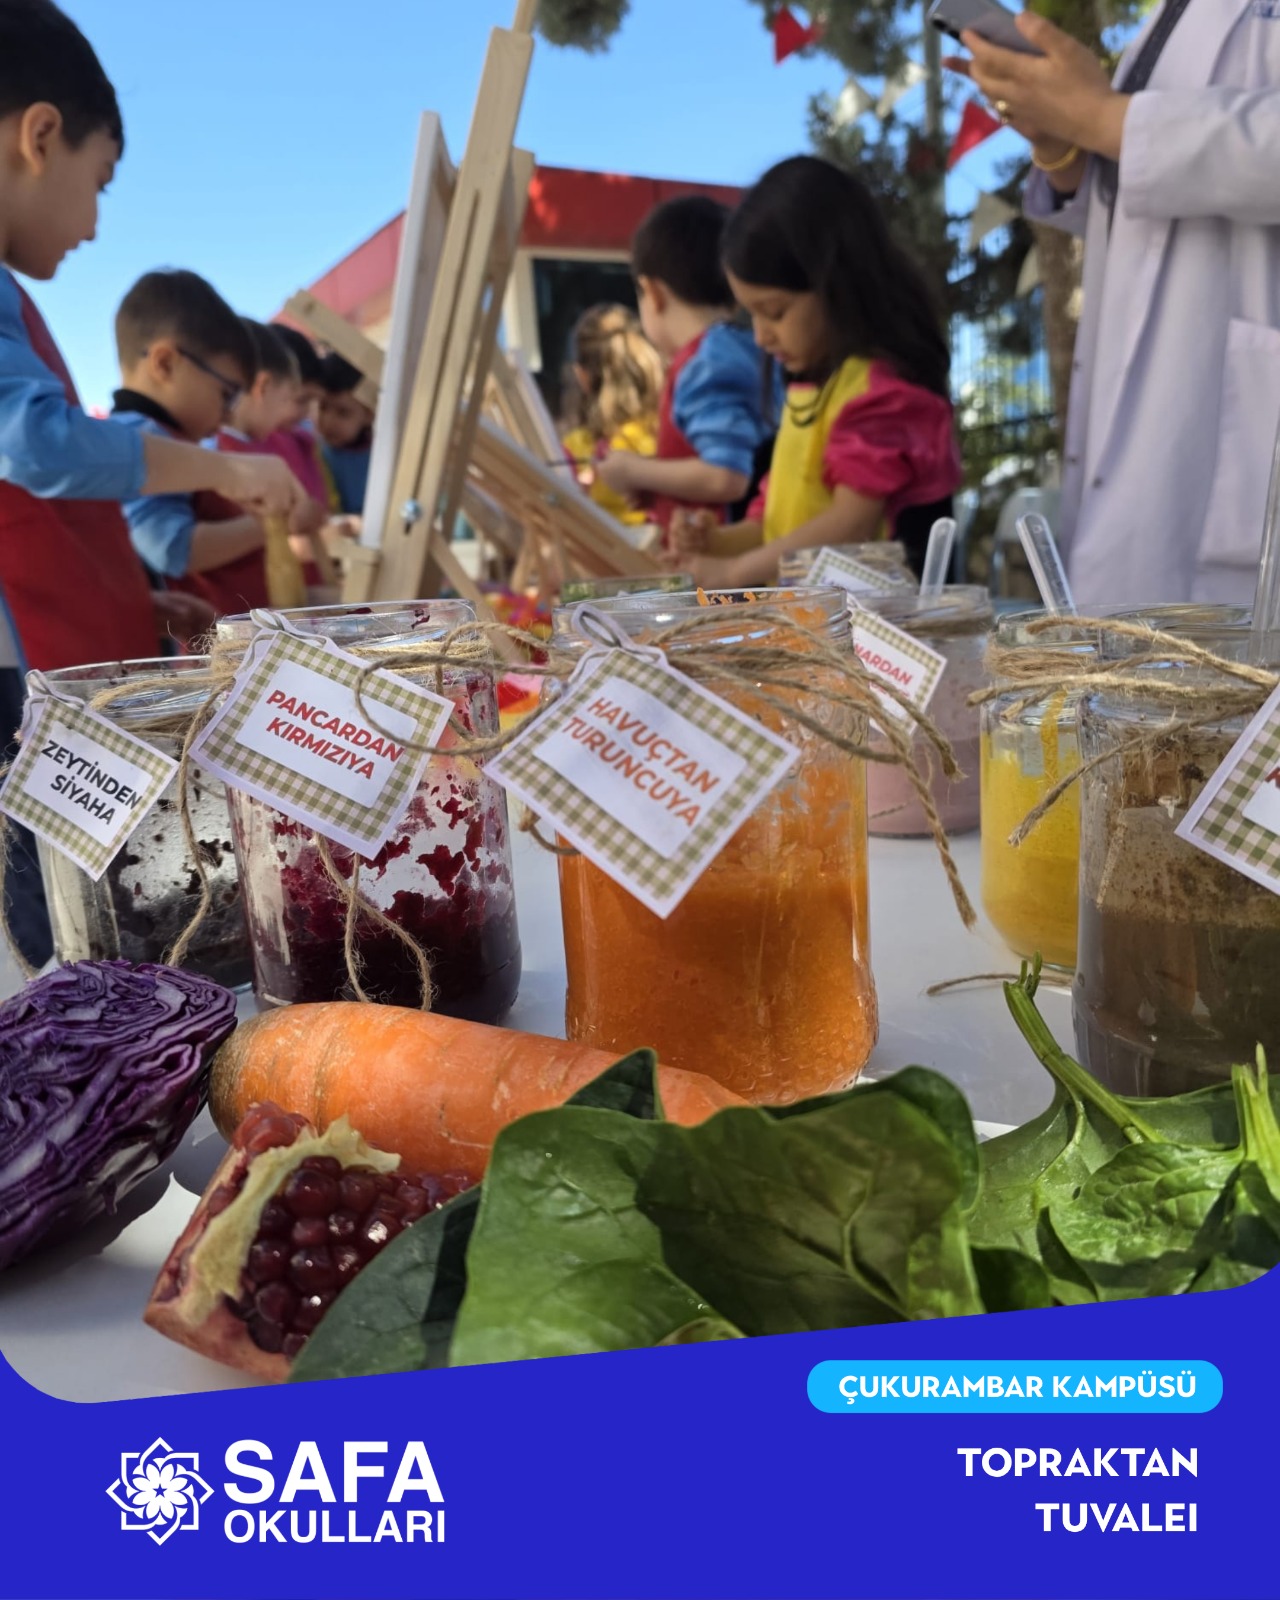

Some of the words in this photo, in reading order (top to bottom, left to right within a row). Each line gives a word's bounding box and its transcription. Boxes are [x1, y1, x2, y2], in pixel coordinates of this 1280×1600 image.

[266, 689, 405, 762] PANCARDAN
[266, 717, 375, 779] KIRMIZIYA
[587, 697, 720, 794] HAVUÇTAN
[41, 740, 143, 810] ZEYTİNDEN
[50, 774, 115, 825] SİYAHA
[562, 716, 702, 827] TURUNCUYA
